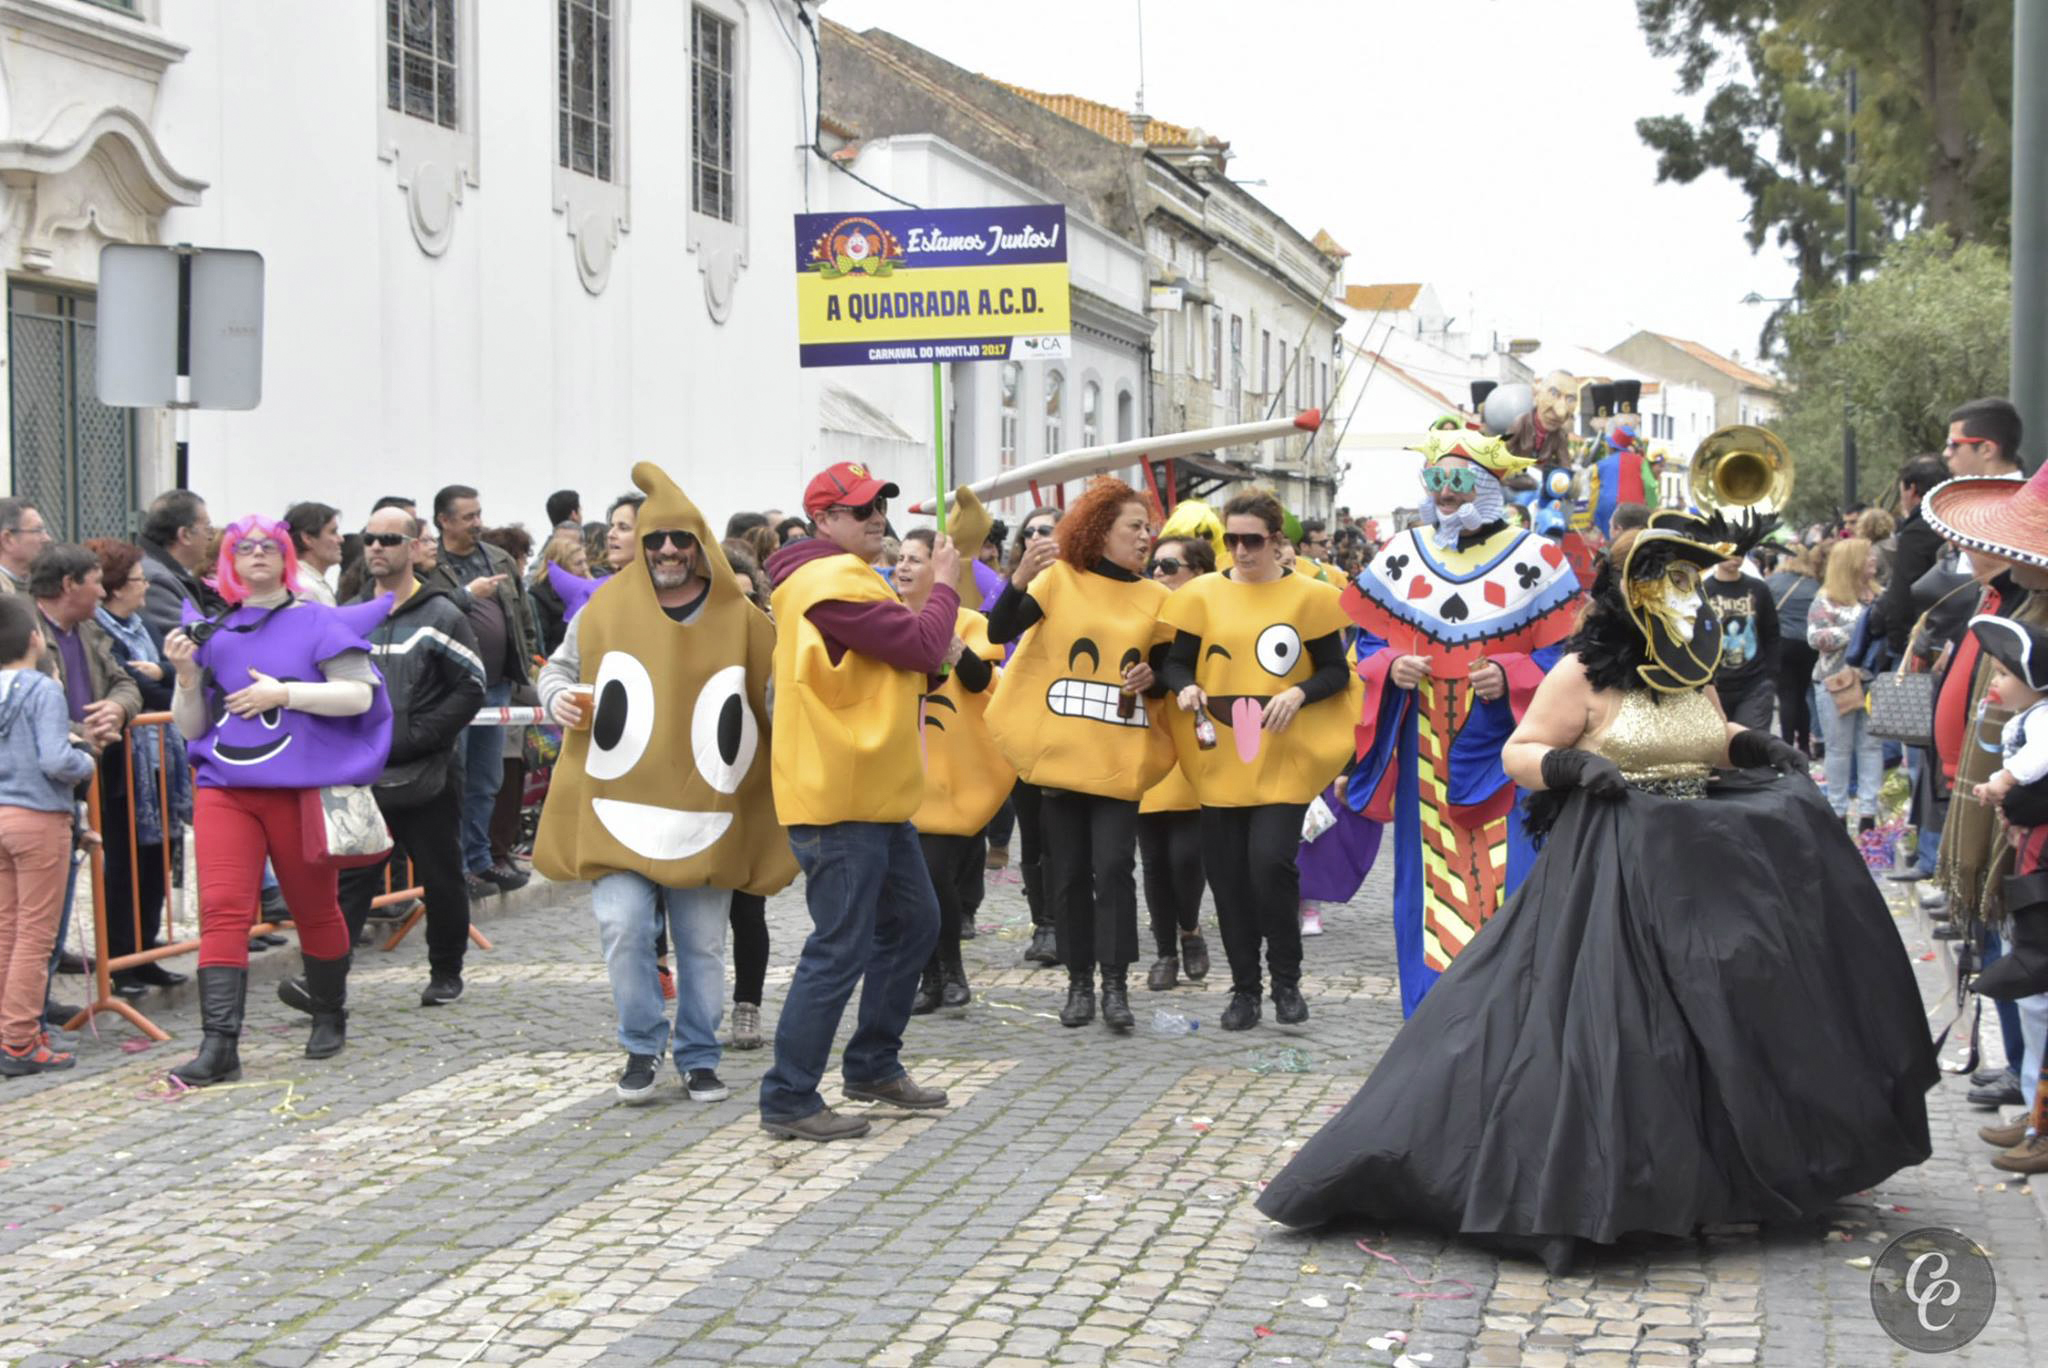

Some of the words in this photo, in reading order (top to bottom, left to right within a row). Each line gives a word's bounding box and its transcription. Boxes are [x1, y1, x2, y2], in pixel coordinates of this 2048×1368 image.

[907, 228, 985, 253] Estamos
[986, 223, 1060, 256] Juntos!
[826, 295, 842, 321] A
[848, 290, 971, 323] QUADRADA
[978, 287, 1044, 316] A.C.D.
[868, 348, 918, 361] CARNAVAL
[920, 347, 934, 359] DO
[936, 345, 980, 358] MONTIJO
[982, 344, 1007, 357] 2017
[1041, 337, 1062, 351] CA
